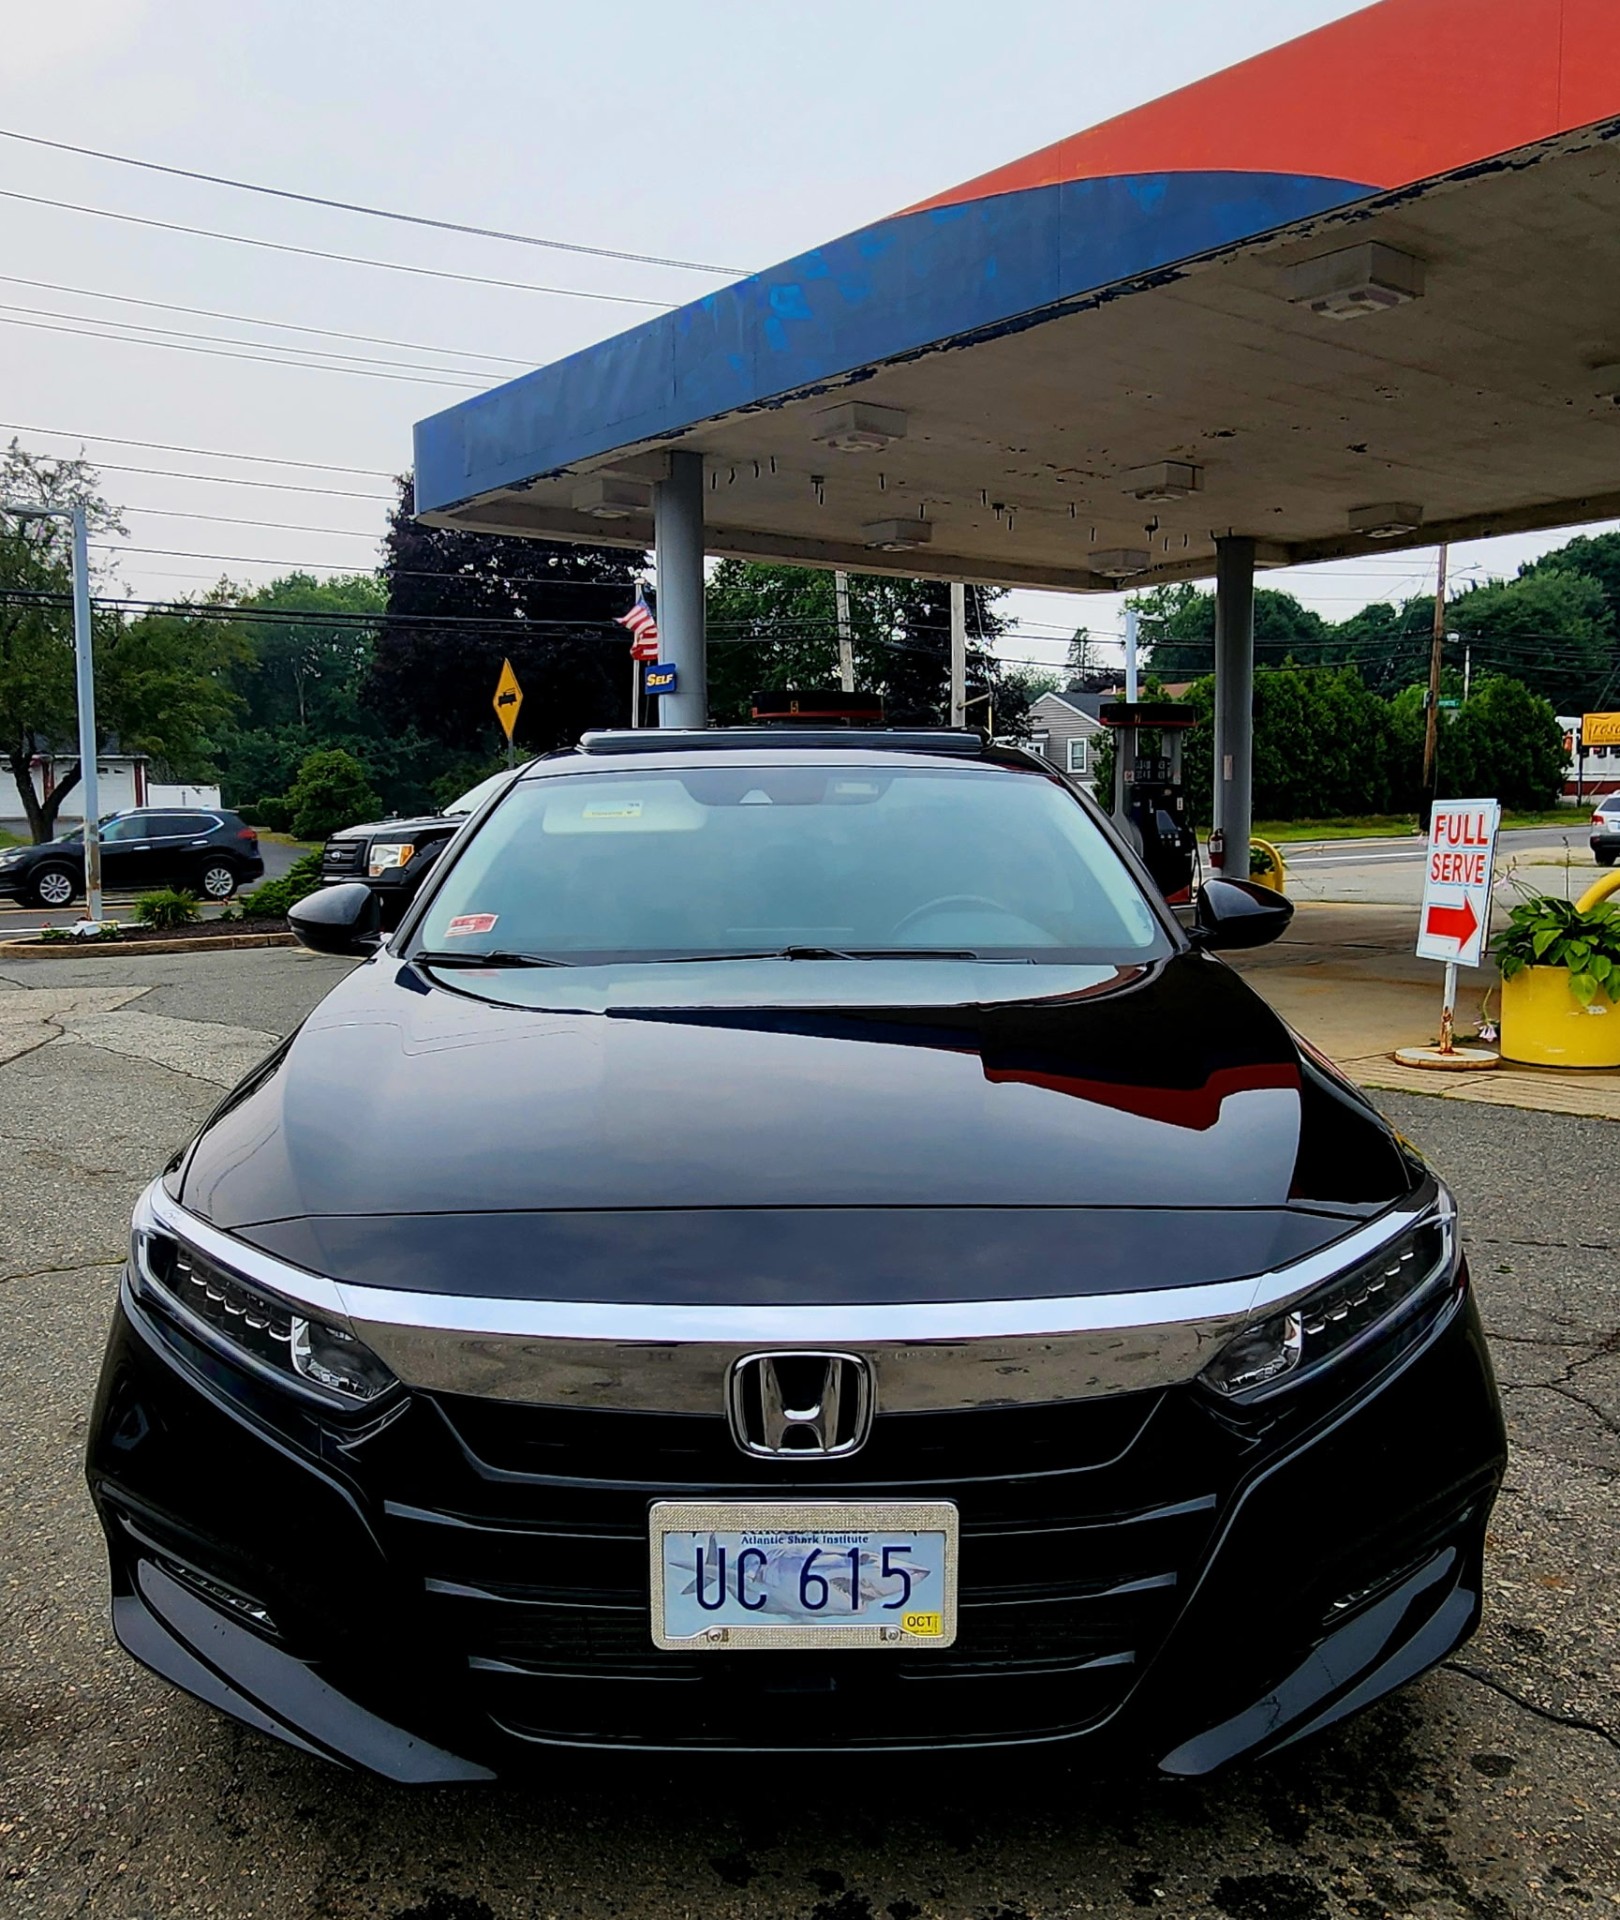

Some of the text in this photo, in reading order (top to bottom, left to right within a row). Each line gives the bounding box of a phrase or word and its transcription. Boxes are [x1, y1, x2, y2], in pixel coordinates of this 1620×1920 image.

[647, 673, 673, 686] SELF
[1434, 814, 1489, 845] FULL
[1430, 853, 1486, 884] SERVE
[741, 1535, 869, 1545] Atlantic Shark Institute
[696, 1546, 912, 1611] UC 615
[907, 1615, 933, 1627] OCT
